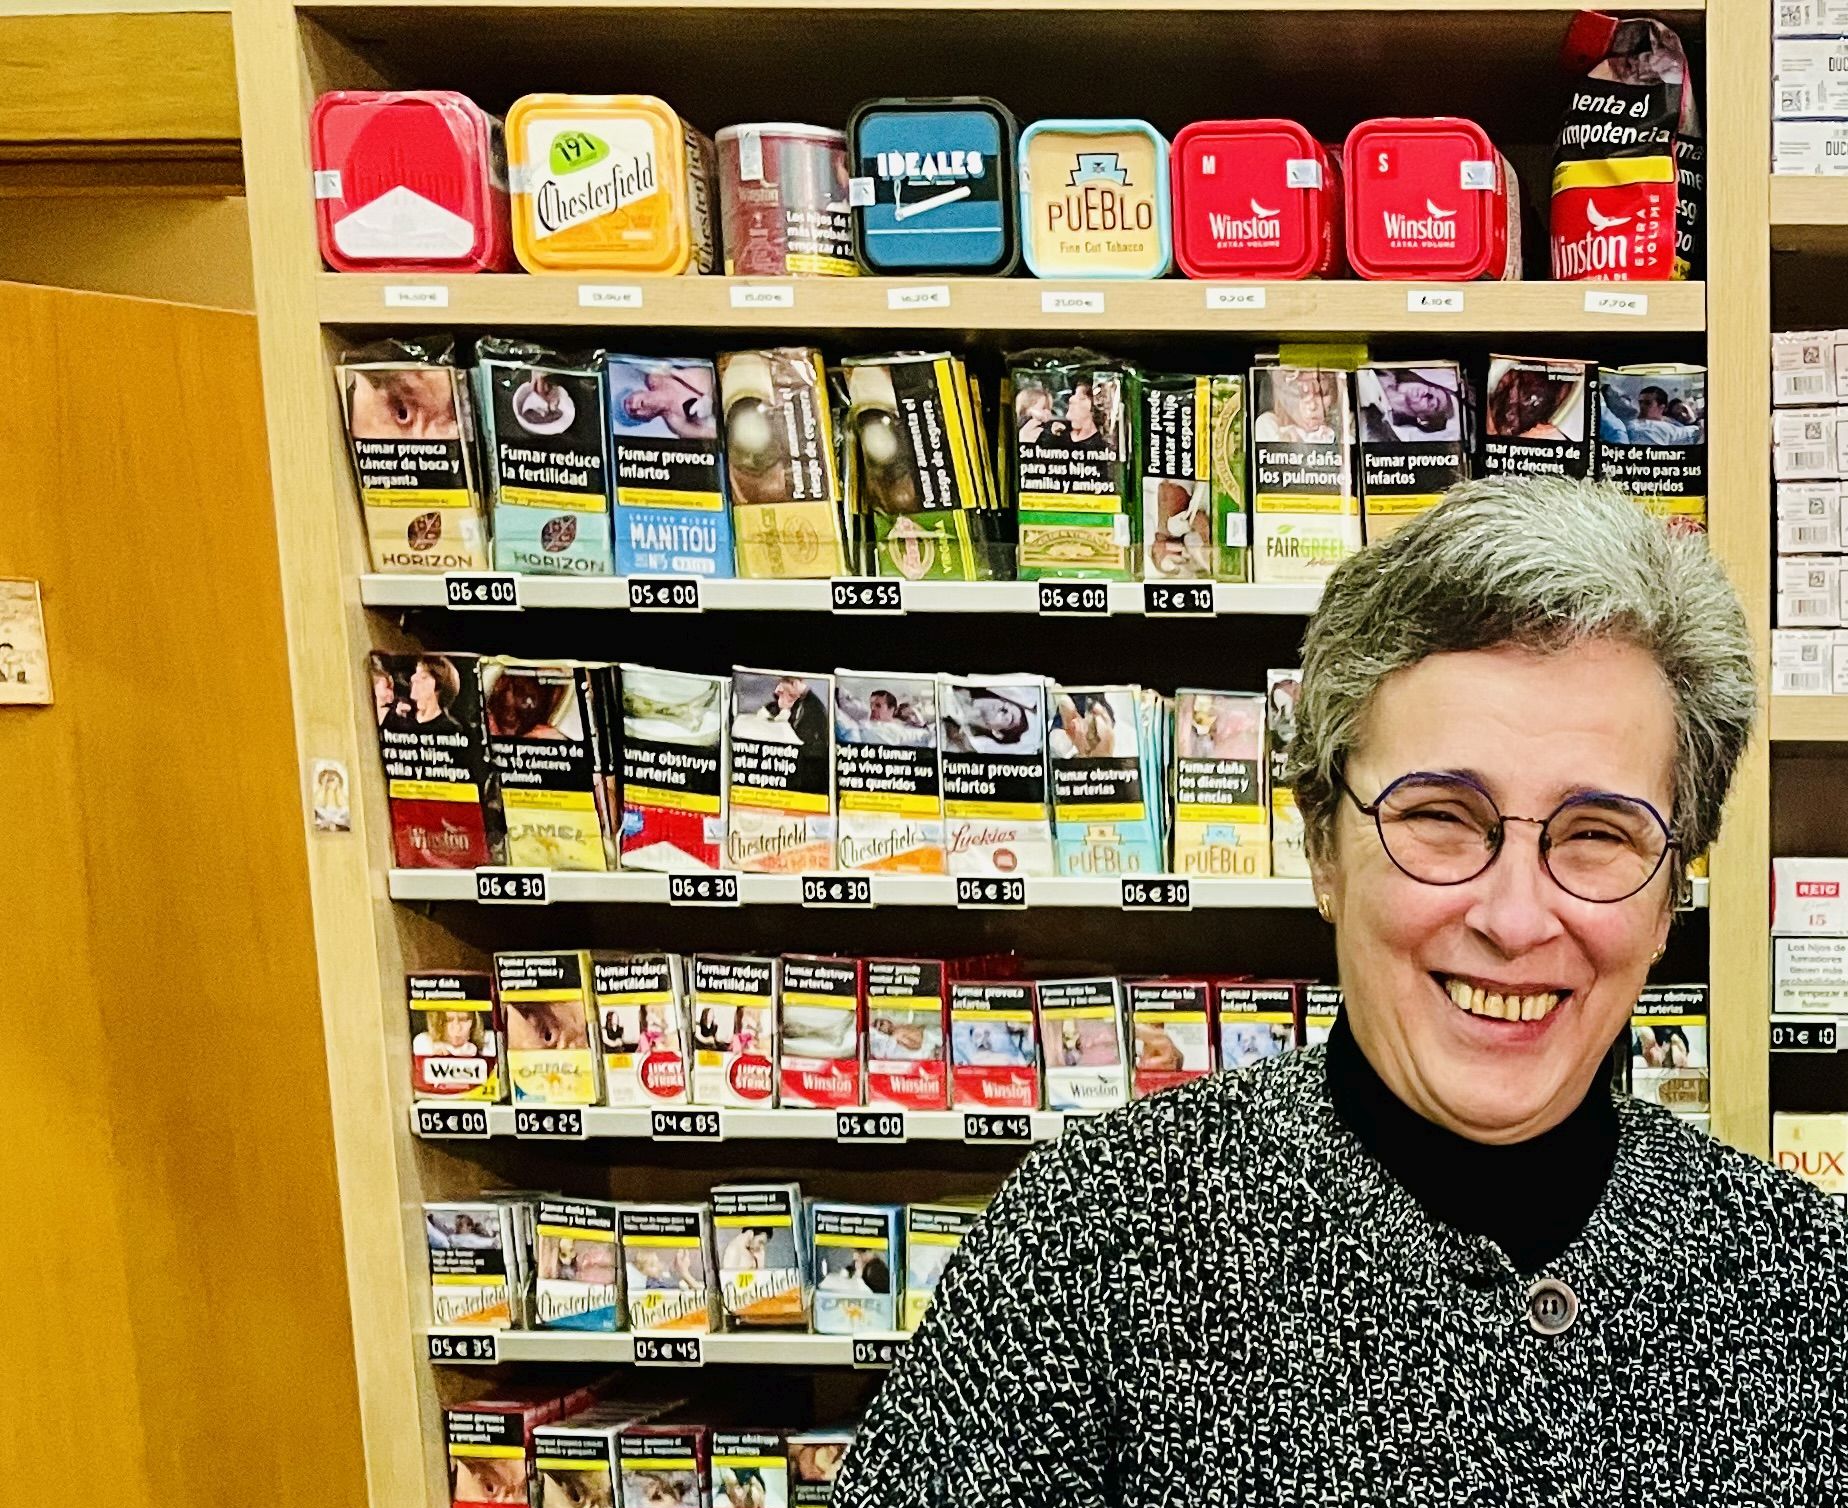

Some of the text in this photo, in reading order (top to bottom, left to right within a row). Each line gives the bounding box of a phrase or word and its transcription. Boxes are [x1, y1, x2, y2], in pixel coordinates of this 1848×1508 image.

[1629, 94, 1649, 117] el
[1563, 122, 1670, 150] impotencia
[555, 133, 596, 160] 191
[877, 150, 985, 180] IDEALES
[1202, 156, 1216, 175] M
[1379, 154, 1388, 173] S
[536, 155, 655, 231] Chesterfield
[1047, 189, 1153, 233] PUEBLO
[1209, 211, 1280, 241] Winston
[1384, 211, 1455, 241] Winston
[1059, 240, 1144, 255] Fine Cut Tobacco
[1147, 390, 1163, 474] Fumar puede
[1163, 395, 1178, 476] matar al hijo
[1181, 406, 1194, 477] que espera
[356, 441, 446, 457] Fumar provoca
[500, 443, 600, 468] Fumar reduce
[618, 445, 714, 467] Fumar provoca
[1020, 445, 1116, 462] Su humo es malo
[1259, 449, 1342, 467] Fumar daña
[1510, 444, 1580, 460] provoca de
[1601, 445, 1626, 460] Deje
[1628, 448, 1645, 461] de
[400, 457, 415, 471] de
[418, 457, 448, 471] boca
[620, 462, 670, 481] infartos
[1020, 462, 1100, 479] para sus hijos,
[1365, 454, 1458, 470] Fumar provoca
[1625, 463, 1702, 478] vivo para sus
[502, 464, 588, 487] la fertilidad
[1259, 467, 1280, 483] los
[1366, 470, 1415, 486] infartos
[1020, 478, 1115, 495] familia amigos
[1632, 479, 1684, 495] queridos
[630, 523, 716, 553] MANITOU
[382, 552, 472, 568] HORIZON
[513, 552, 605, 572] HORIZON
[659, 752, 716, 772] obstruye
[944, 759, 1042, 779] Fumar provoca
[944, 777, 996, 795] infartos
[1069, 845, 1139, 874] PUEBLO
[1185, 845, 1255, 874] PUEBLO
[1799, 884, 1837, 896] REIG
[431, 1062, 481, 1081] West
[1070, 1080, 1118, 1098] Winston
[1778, 1152, 1844, 1176] DUX
